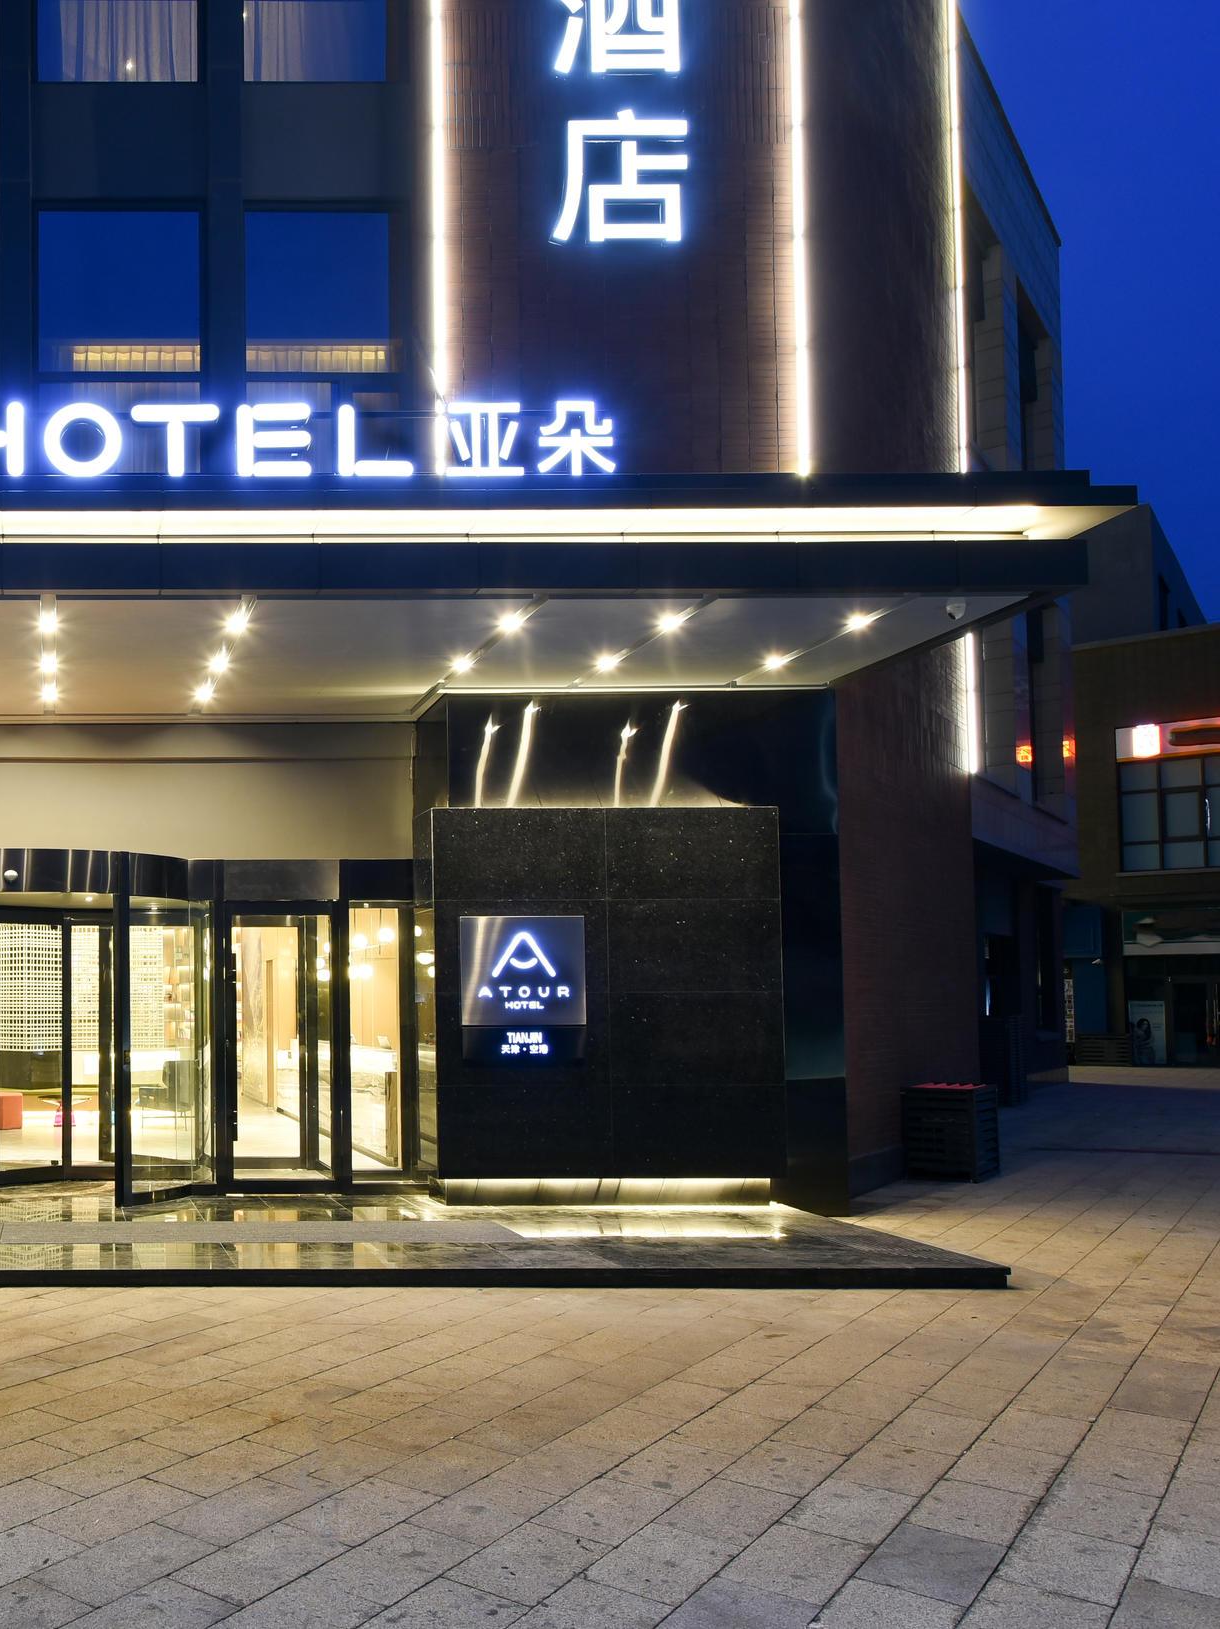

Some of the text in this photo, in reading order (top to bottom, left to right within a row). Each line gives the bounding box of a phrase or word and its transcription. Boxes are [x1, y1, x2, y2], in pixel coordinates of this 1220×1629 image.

[554, 0, 688, 242] 酒店
[446, 400, 616, 477] 亚朵
[478, 986, 570, 998] ATOUR
[504, 1001, 545, 1010] HOTEL
[506, 1032, 543, 1044] TIANJIN
